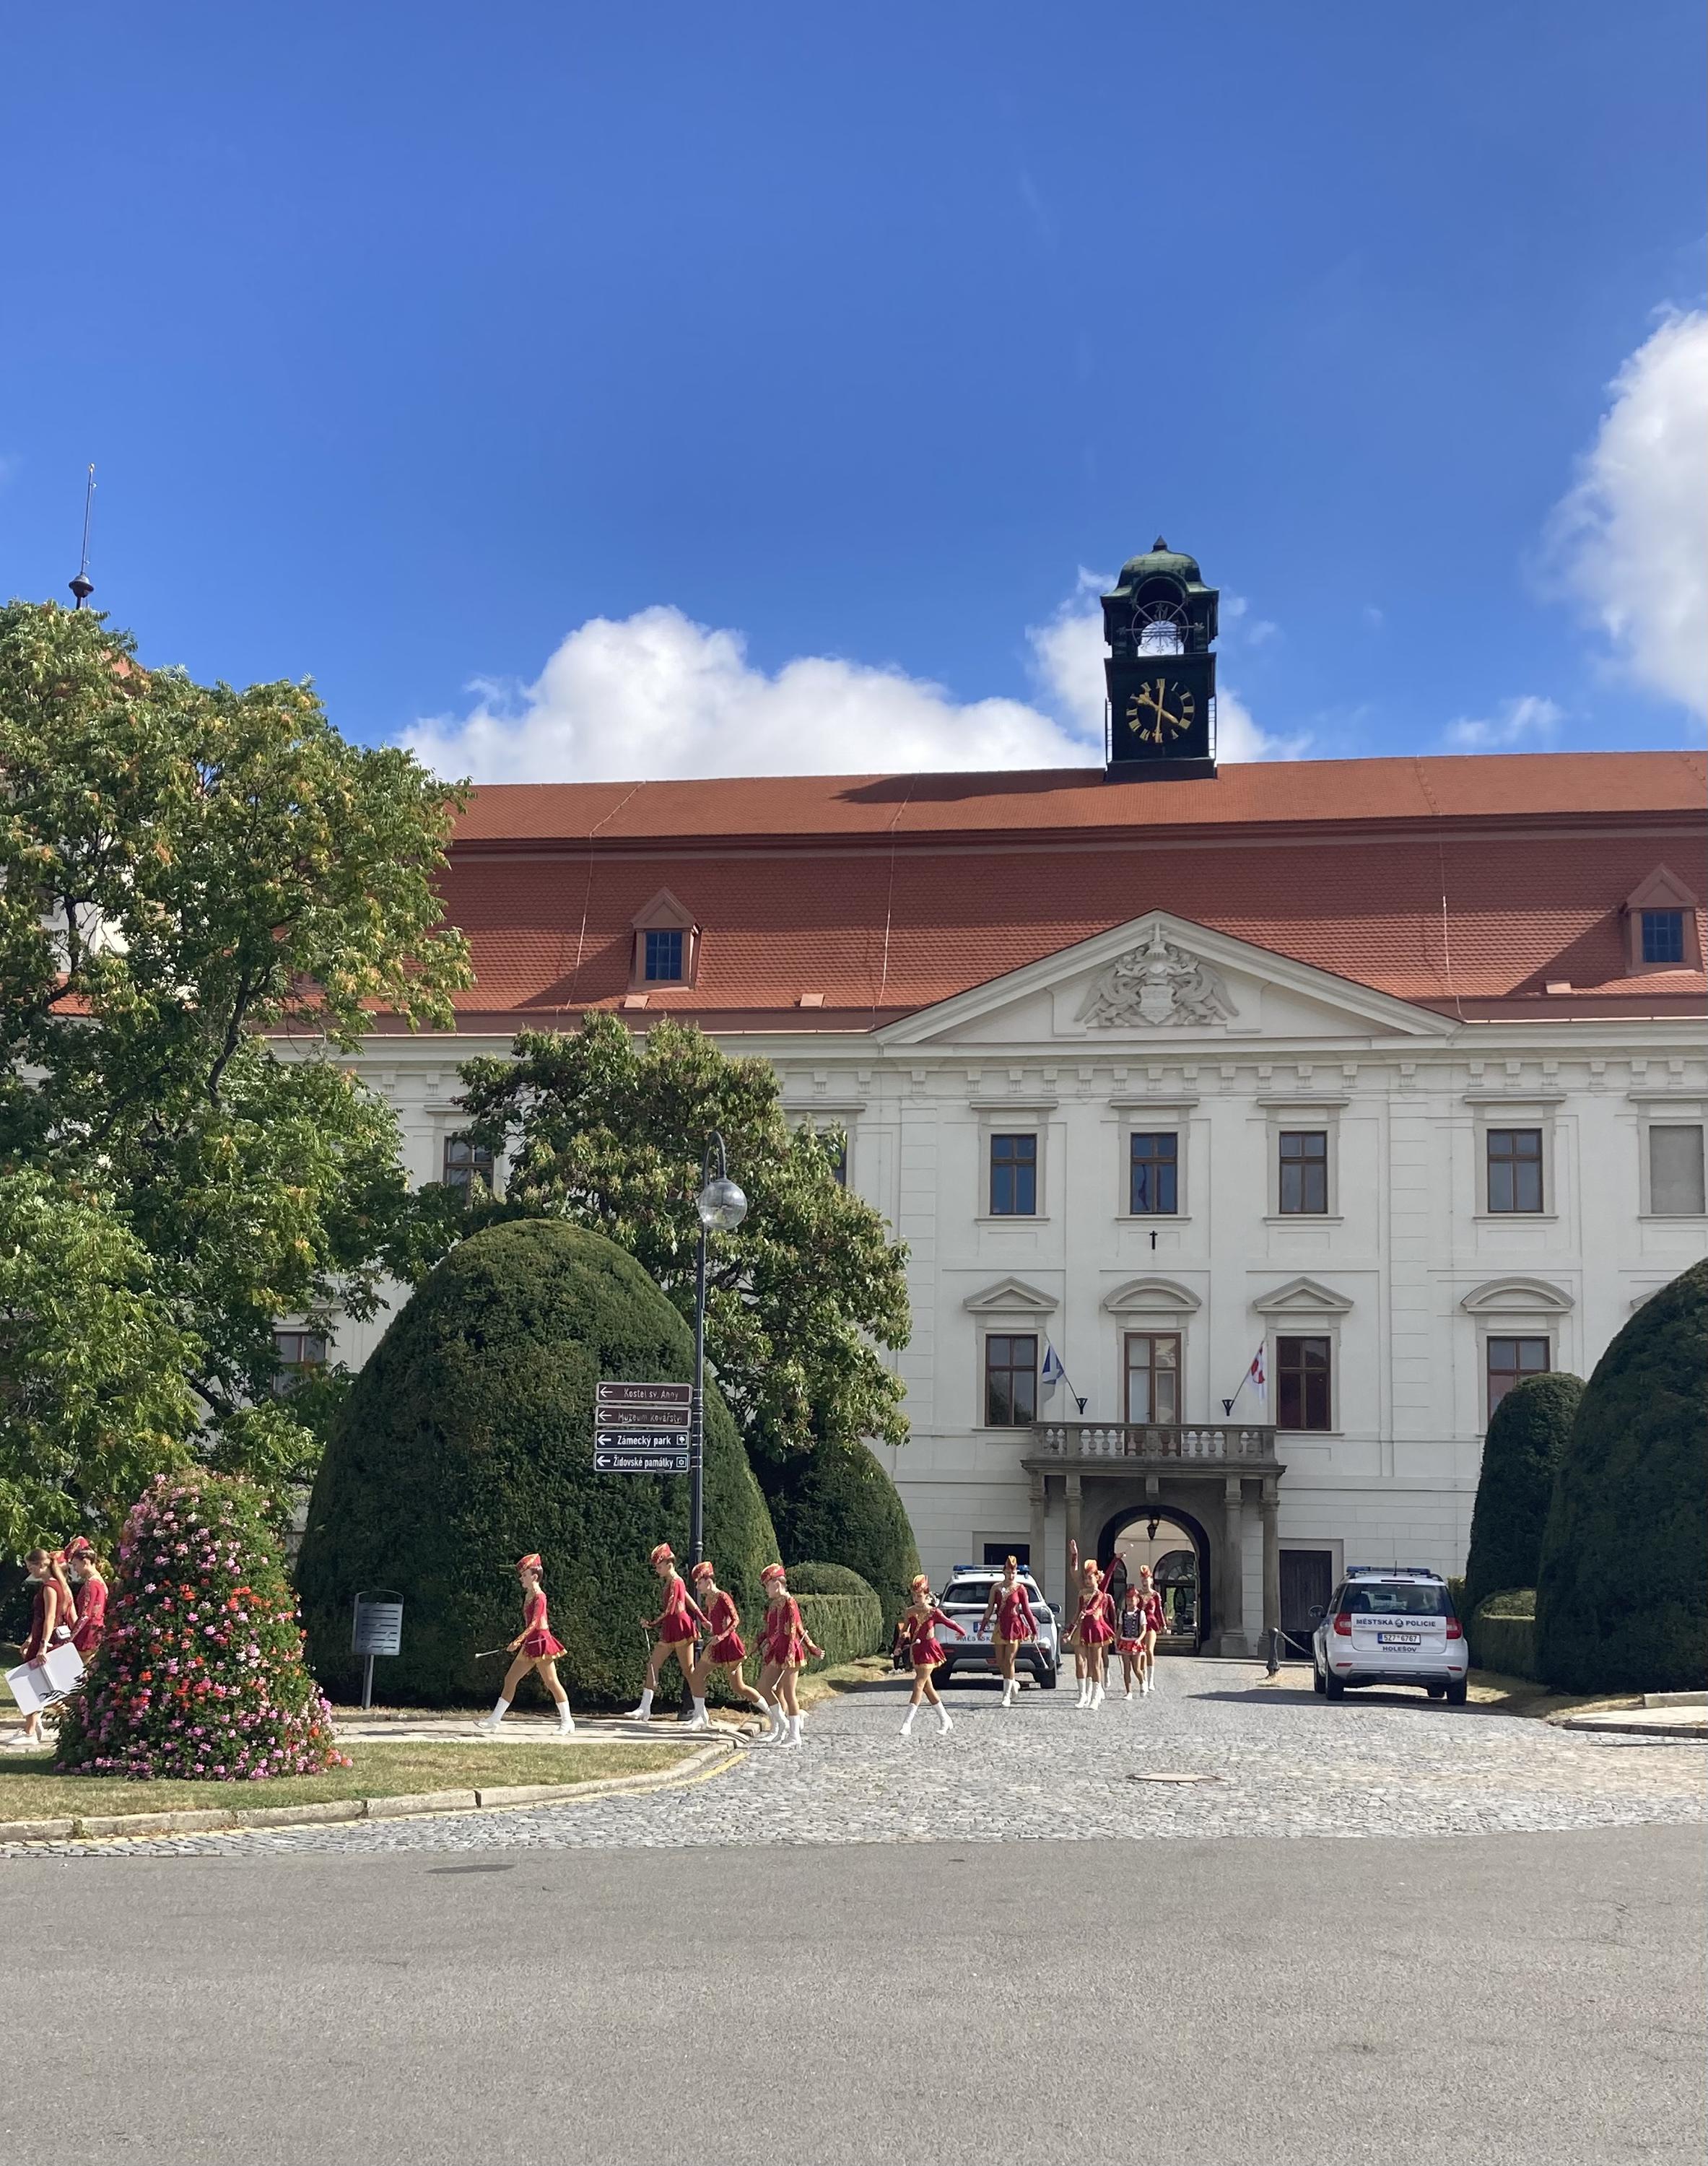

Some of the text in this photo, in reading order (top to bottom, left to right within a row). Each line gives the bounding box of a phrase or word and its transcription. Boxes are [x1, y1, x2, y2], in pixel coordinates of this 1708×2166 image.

[624, 1388, 648, 1399] Kostel
[661, 1390, 679, 1401] Anny
[617, 1435, 671, 1447] Zámecký park
[613, 1454, 674, 1469] Židovské památky
